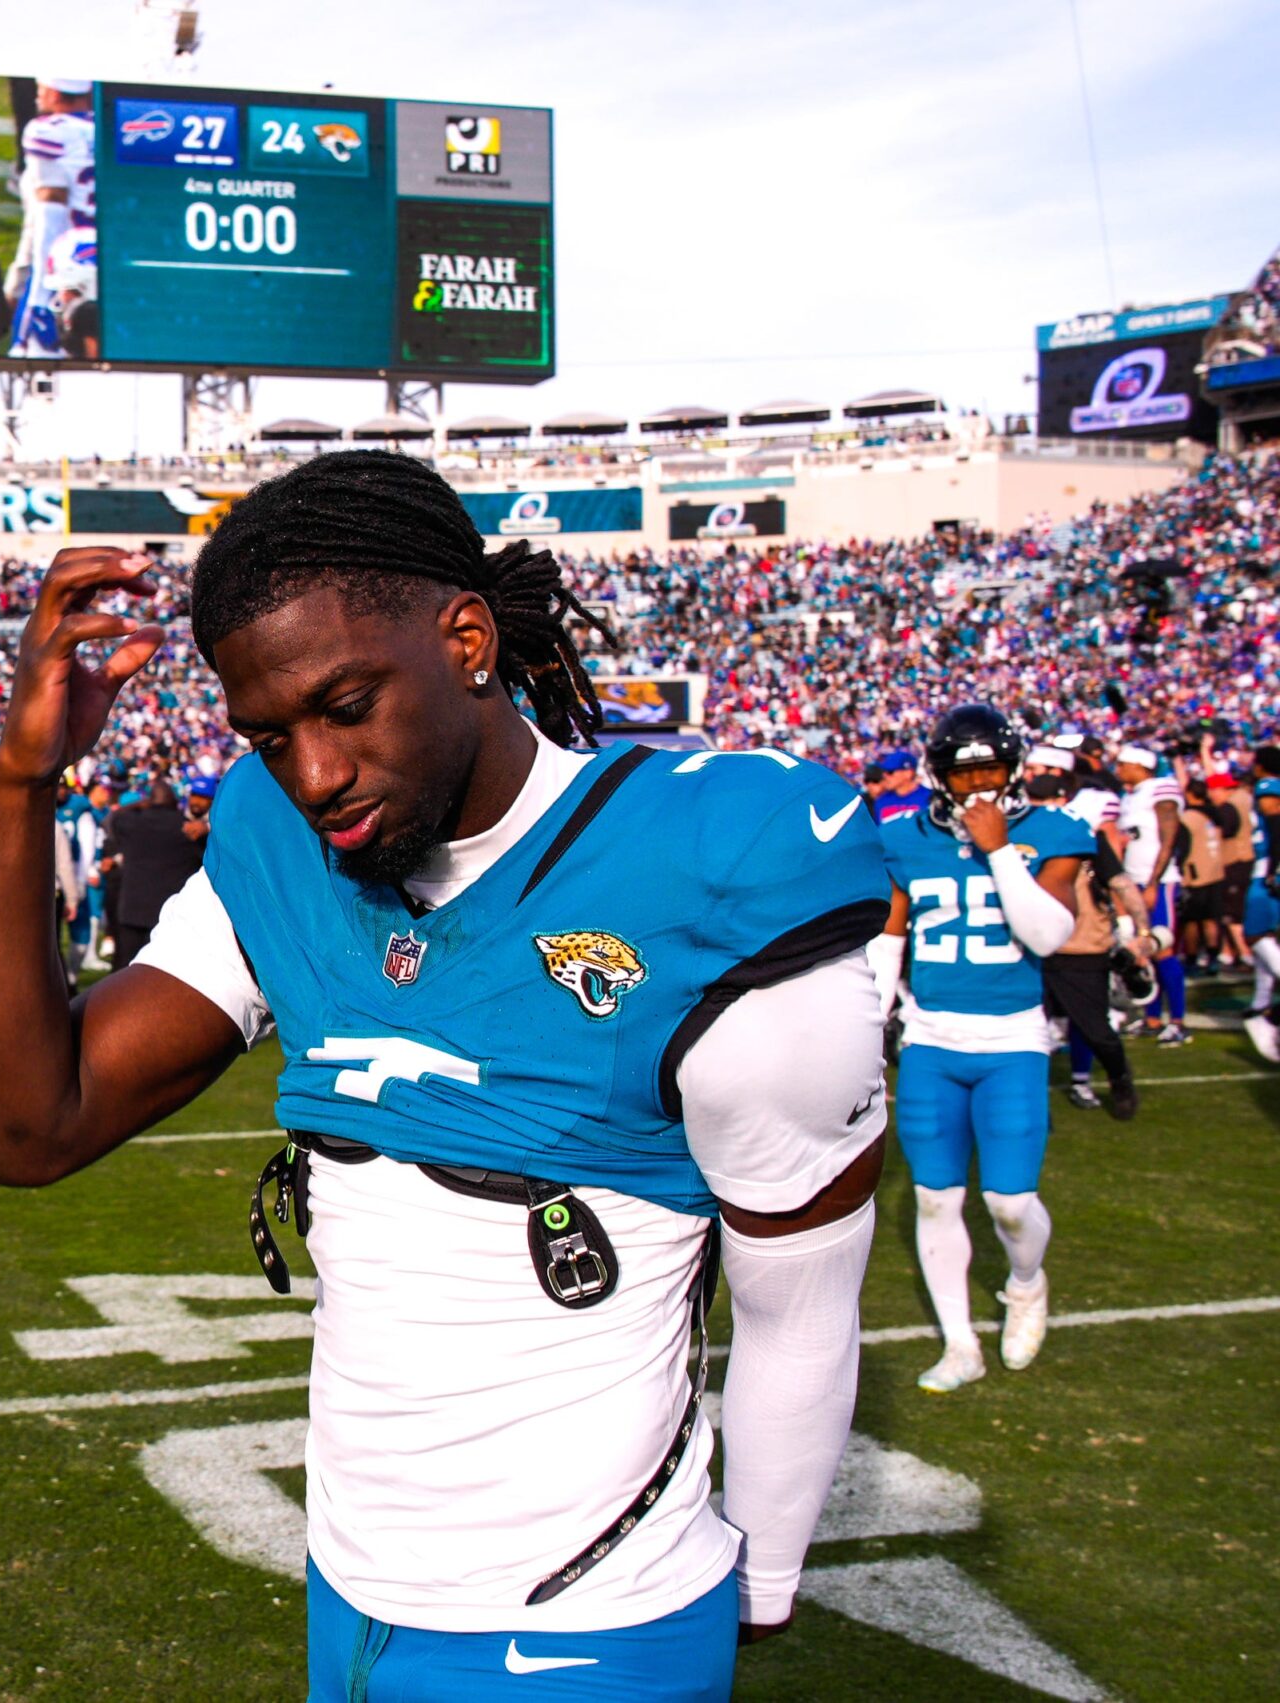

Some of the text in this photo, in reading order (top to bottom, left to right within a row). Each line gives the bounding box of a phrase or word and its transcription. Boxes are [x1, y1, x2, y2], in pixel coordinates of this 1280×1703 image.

[182, 115, 227, 150] 27
[261, 120, 306, 154] 24
[449, 153, 497, 173] PRI
[217, 180, 296, 199] QUARTER
[185, 201, 297, 255] 0:00
[421, 253, 517, 284] FARAH
[413, 280, 538, 312] & FARAH
[1053, 315, 1114, 337] ASAP
[908, 876, 1024, 965] 25
[387, 953, 413, 979] NFL
